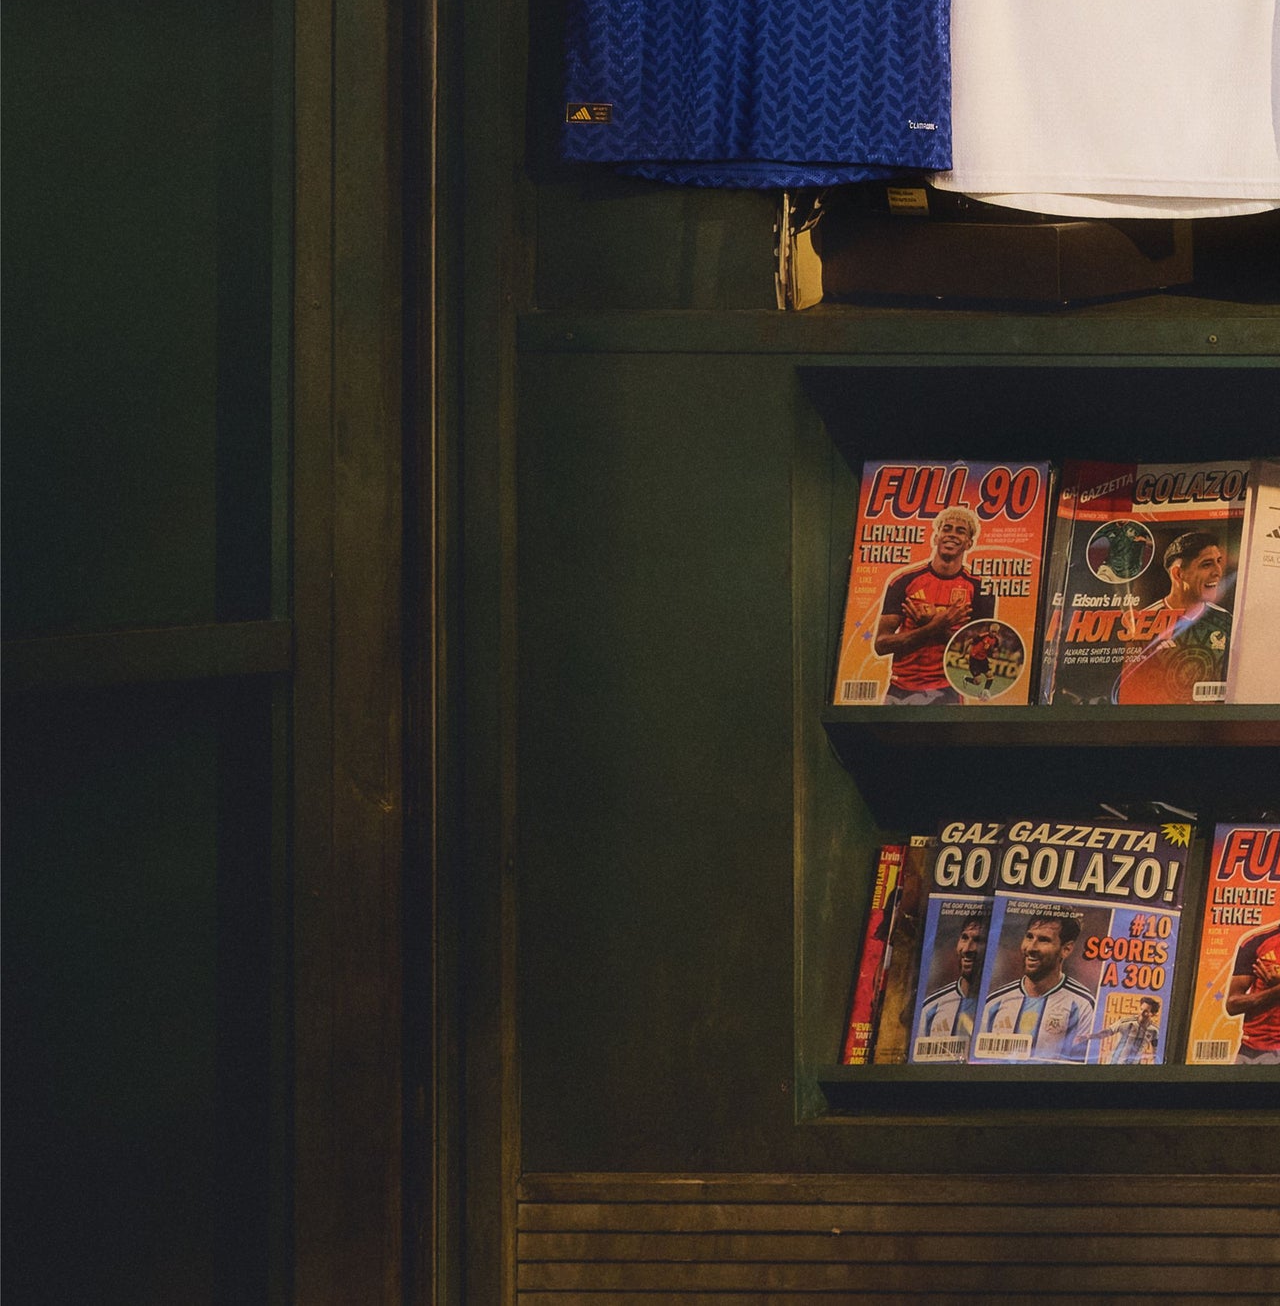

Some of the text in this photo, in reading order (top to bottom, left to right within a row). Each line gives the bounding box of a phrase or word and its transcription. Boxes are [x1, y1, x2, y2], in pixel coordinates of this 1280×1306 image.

[864, 465, 1041, 522] FULL 90
[1080, 473, 1134, 504] GAZZETTA
[861, 524, 926, 544] LAMINE
[860, 544, 911, 564] TAKES
[971, 557, 1032, 576] CENTRE
[980, 578, 1031, 597] STAGE
[1071, 593, 1140, 608] Edson's in the
[1065, 608, 1186, 643] HOT SEAT
[1009, 821, 1157, 853] GAZZETTA
[881, 851, 900, 861] Livin
[1000, 844, 1180, 902] GOLAZO!
[1213, 887, 1277, 905] LAMINE
[1130, 914, 1173, 939] #10
[1211, 907, 1262, 926] TAKES
[1083, 935, 1170, 965] SCORES
[1101, 962, 1165, 990] A 300
